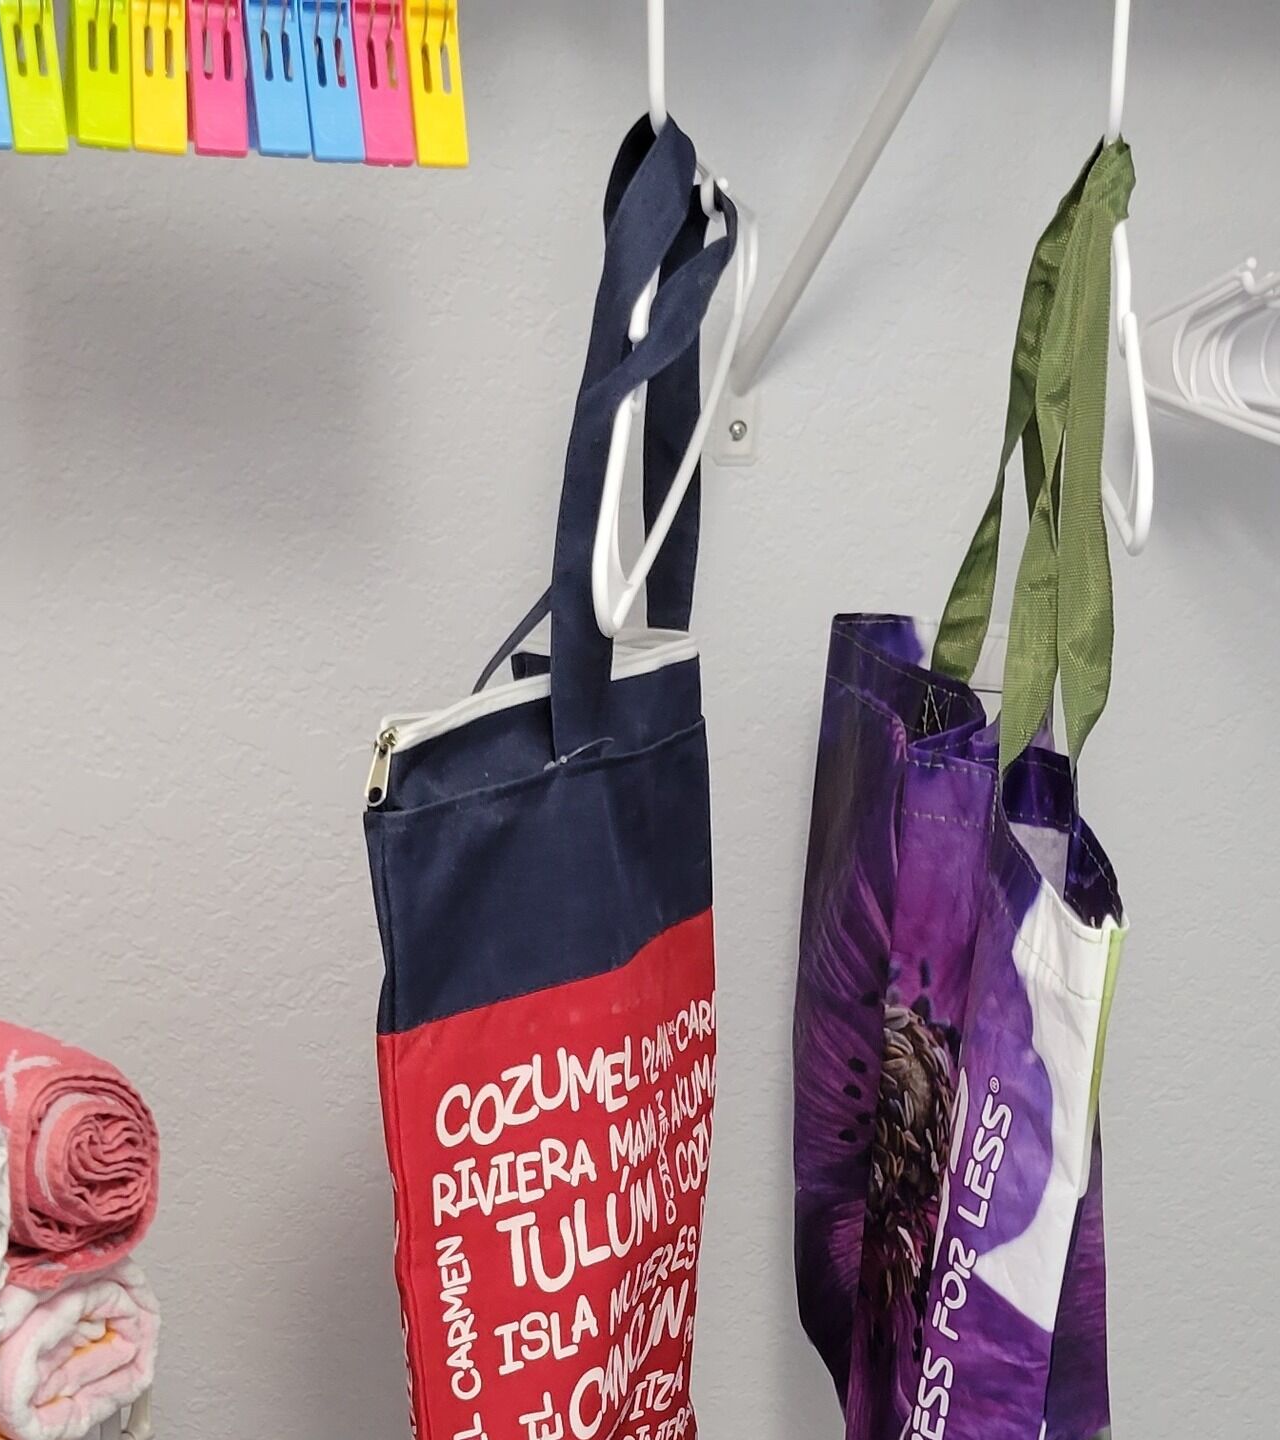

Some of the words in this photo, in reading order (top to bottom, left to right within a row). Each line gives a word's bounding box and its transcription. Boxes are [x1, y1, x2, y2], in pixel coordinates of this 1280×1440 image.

[435, 1035, 640, 1148] COZUMEL
[432, 1138, 597, 1226] RIVIERA
[609, 1104, 657, 1172] MAYA
[435, 1235, 482, 1400] CARMEN
[494, 1294, 598, 1376] ISLA
[932, 1237, 977, 1341] FOR
[629, 1361, 684, 1422] ITZA
